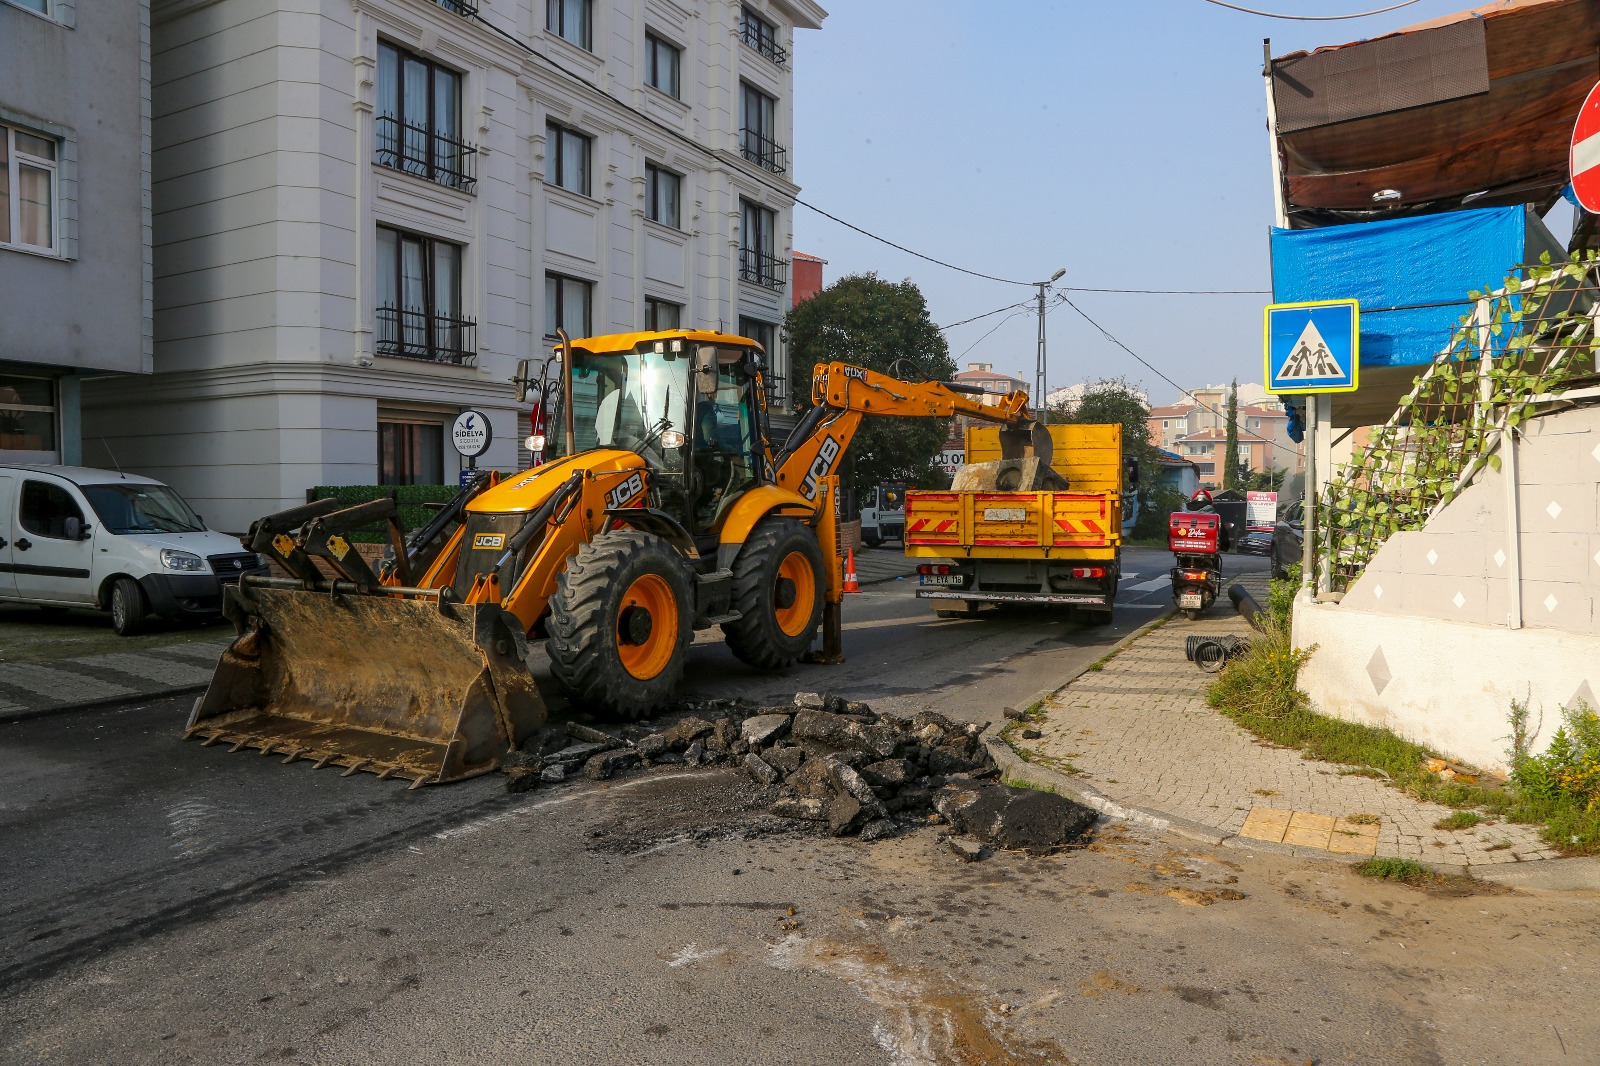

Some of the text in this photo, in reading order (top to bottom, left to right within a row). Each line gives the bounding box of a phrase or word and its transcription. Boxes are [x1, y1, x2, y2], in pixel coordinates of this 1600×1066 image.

[455, 430, 484, 438] SİDELYA
[806, 437, 839, 500] JCB
[608, 473, 643, 510] JCB
[475, 536, 502, 546] JCB
